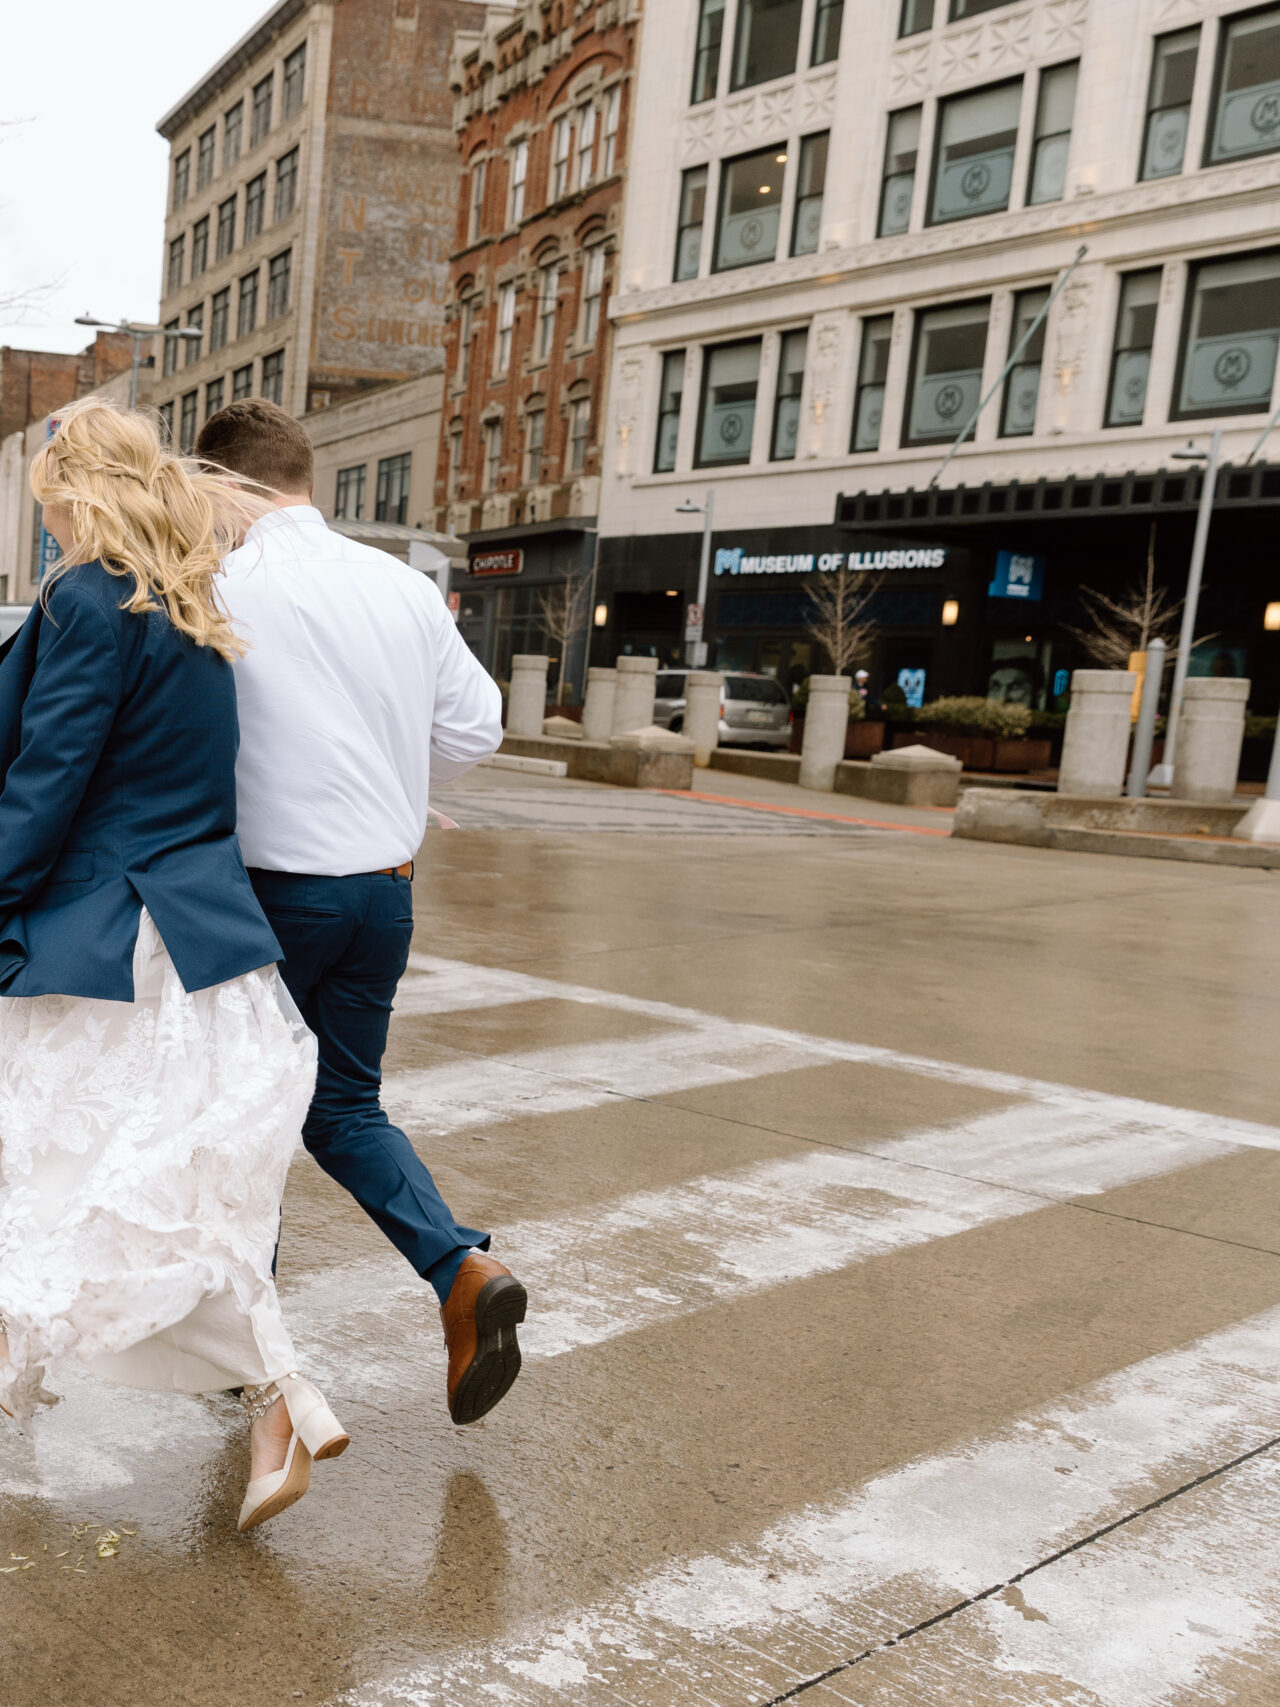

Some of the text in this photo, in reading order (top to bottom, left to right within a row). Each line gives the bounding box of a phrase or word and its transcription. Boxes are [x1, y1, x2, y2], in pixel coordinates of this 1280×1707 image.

[473, 553, 515, 571] CHIPOTLE
[740, 549, 945, 574] MUSEUM OF ILLUSIONS
